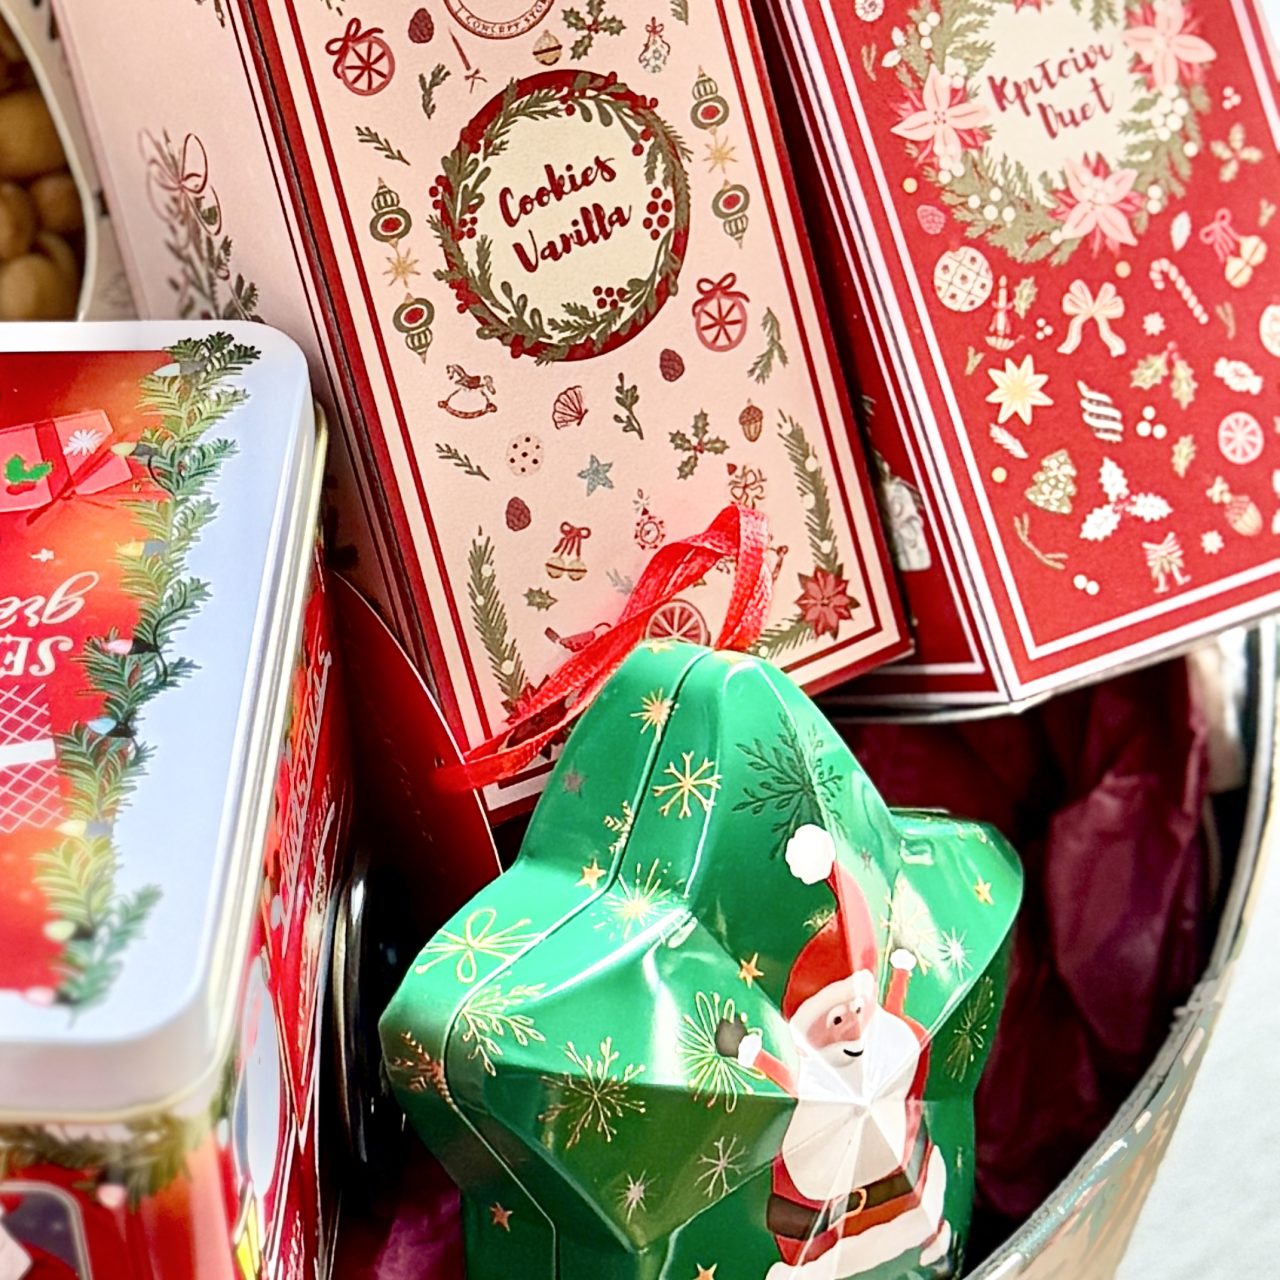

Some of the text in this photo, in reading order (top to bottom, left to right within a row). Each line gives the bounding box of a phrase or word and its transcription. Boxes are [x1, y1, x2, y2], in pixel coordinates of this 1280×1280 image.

[1037, 77, 1114, 139] Duet
[499, 155, 617, 228] Cookies
[512, 203, 632, 273] Vanilla
